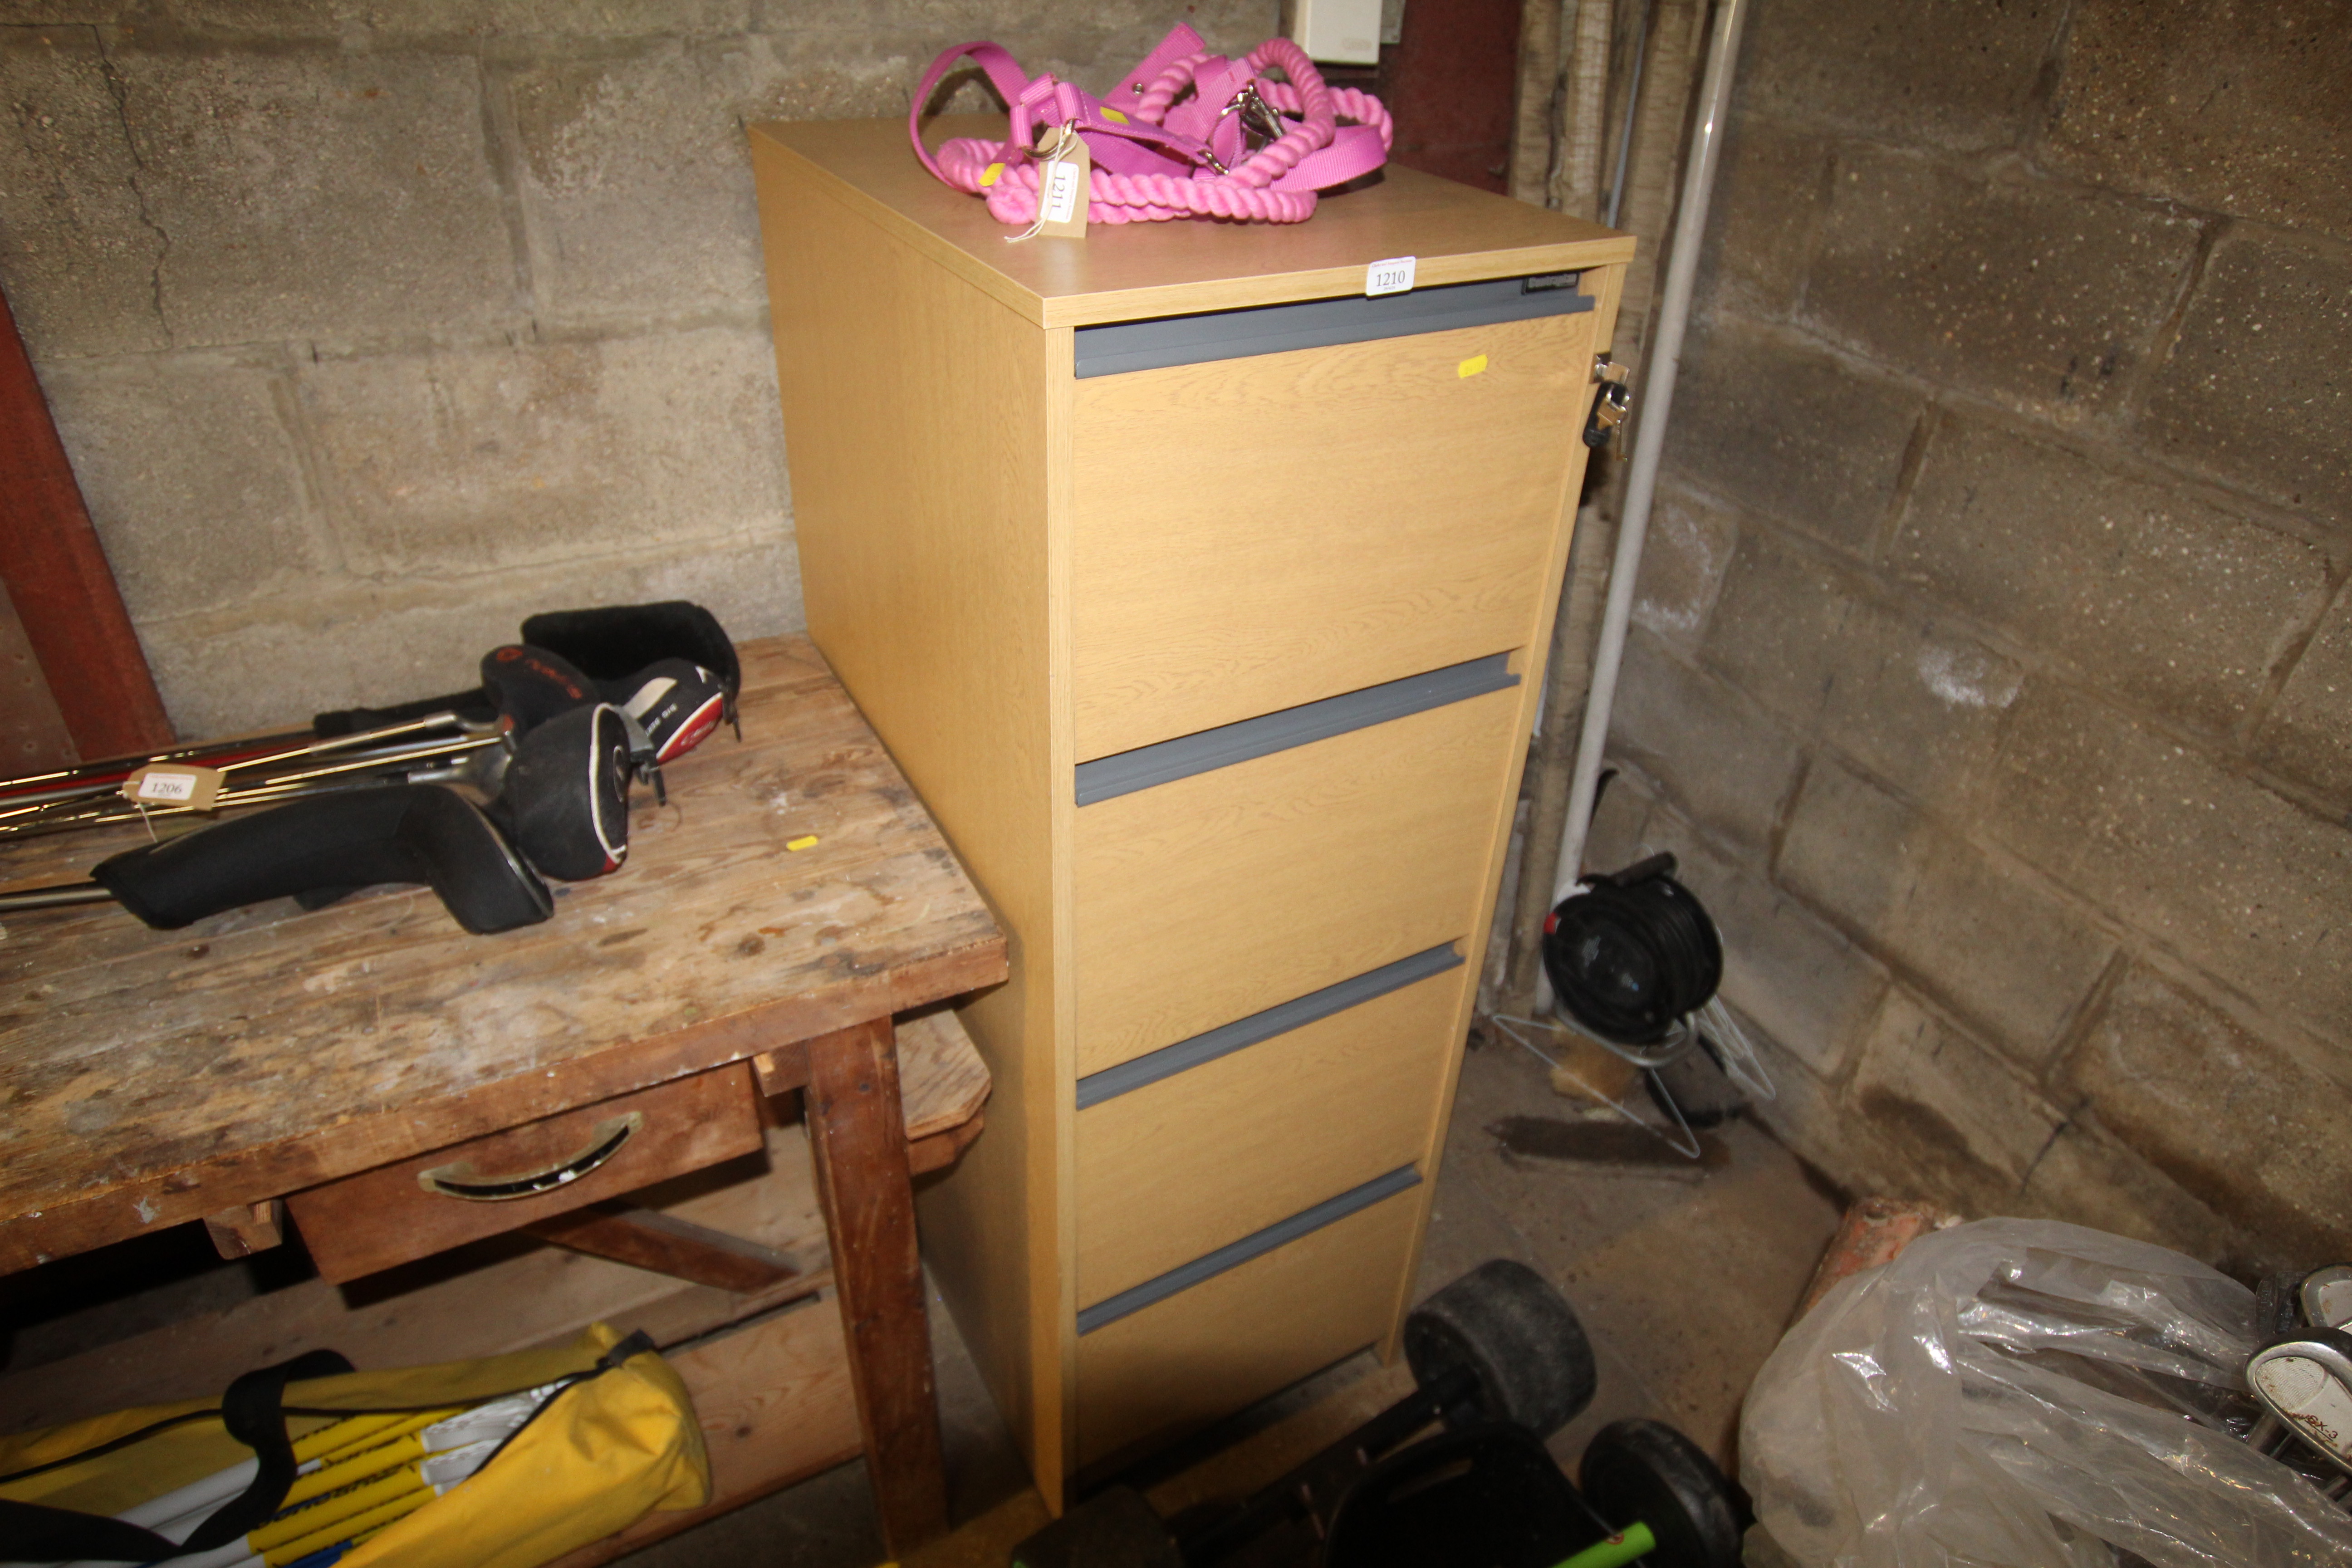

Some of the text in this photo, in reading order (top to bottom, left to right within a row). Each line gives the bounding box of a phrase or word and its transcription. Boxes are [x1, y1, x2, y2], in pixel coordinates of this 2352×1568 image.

[1052, 175, 1065, 208] 1211
[1377, 270, 1406, 287] 1210
[152, 783, 182, 793] 1206
